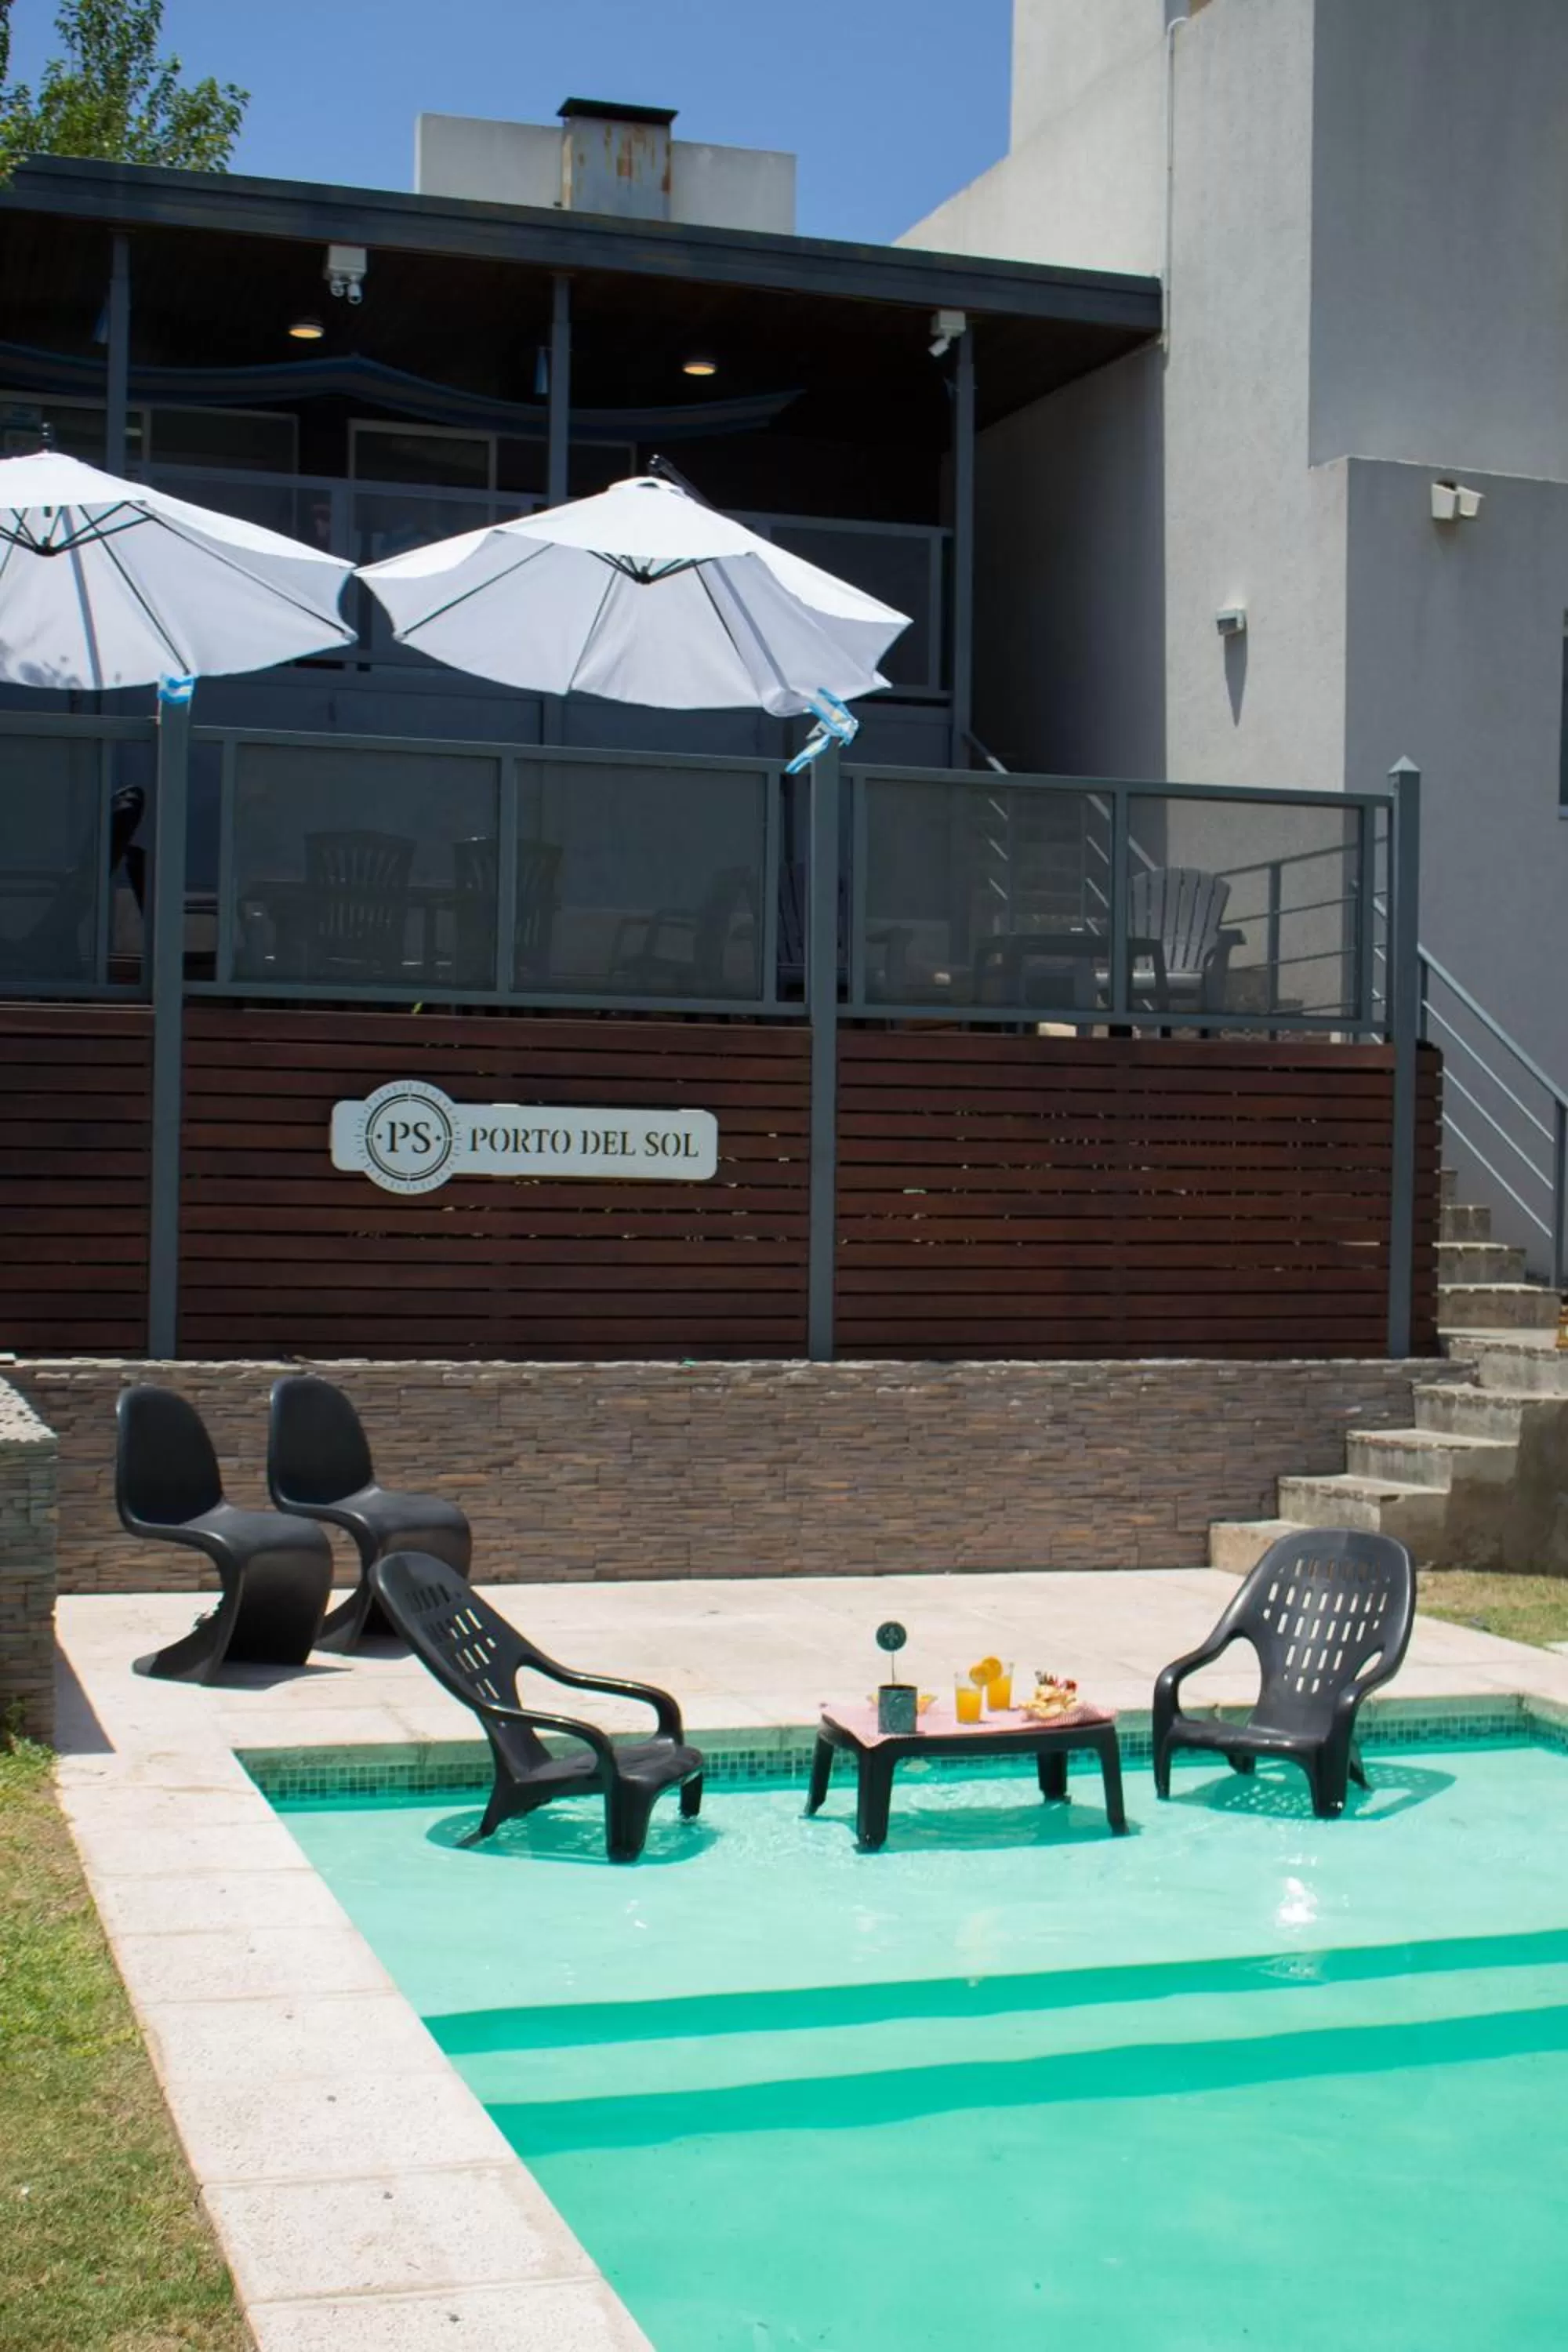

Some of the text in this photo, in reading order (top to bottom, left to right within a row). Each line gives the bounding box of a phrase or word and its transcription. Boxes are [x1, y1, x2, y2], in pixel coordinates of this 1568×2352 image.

[469, 1127, 699, 1158] PORTO DEL SOL
